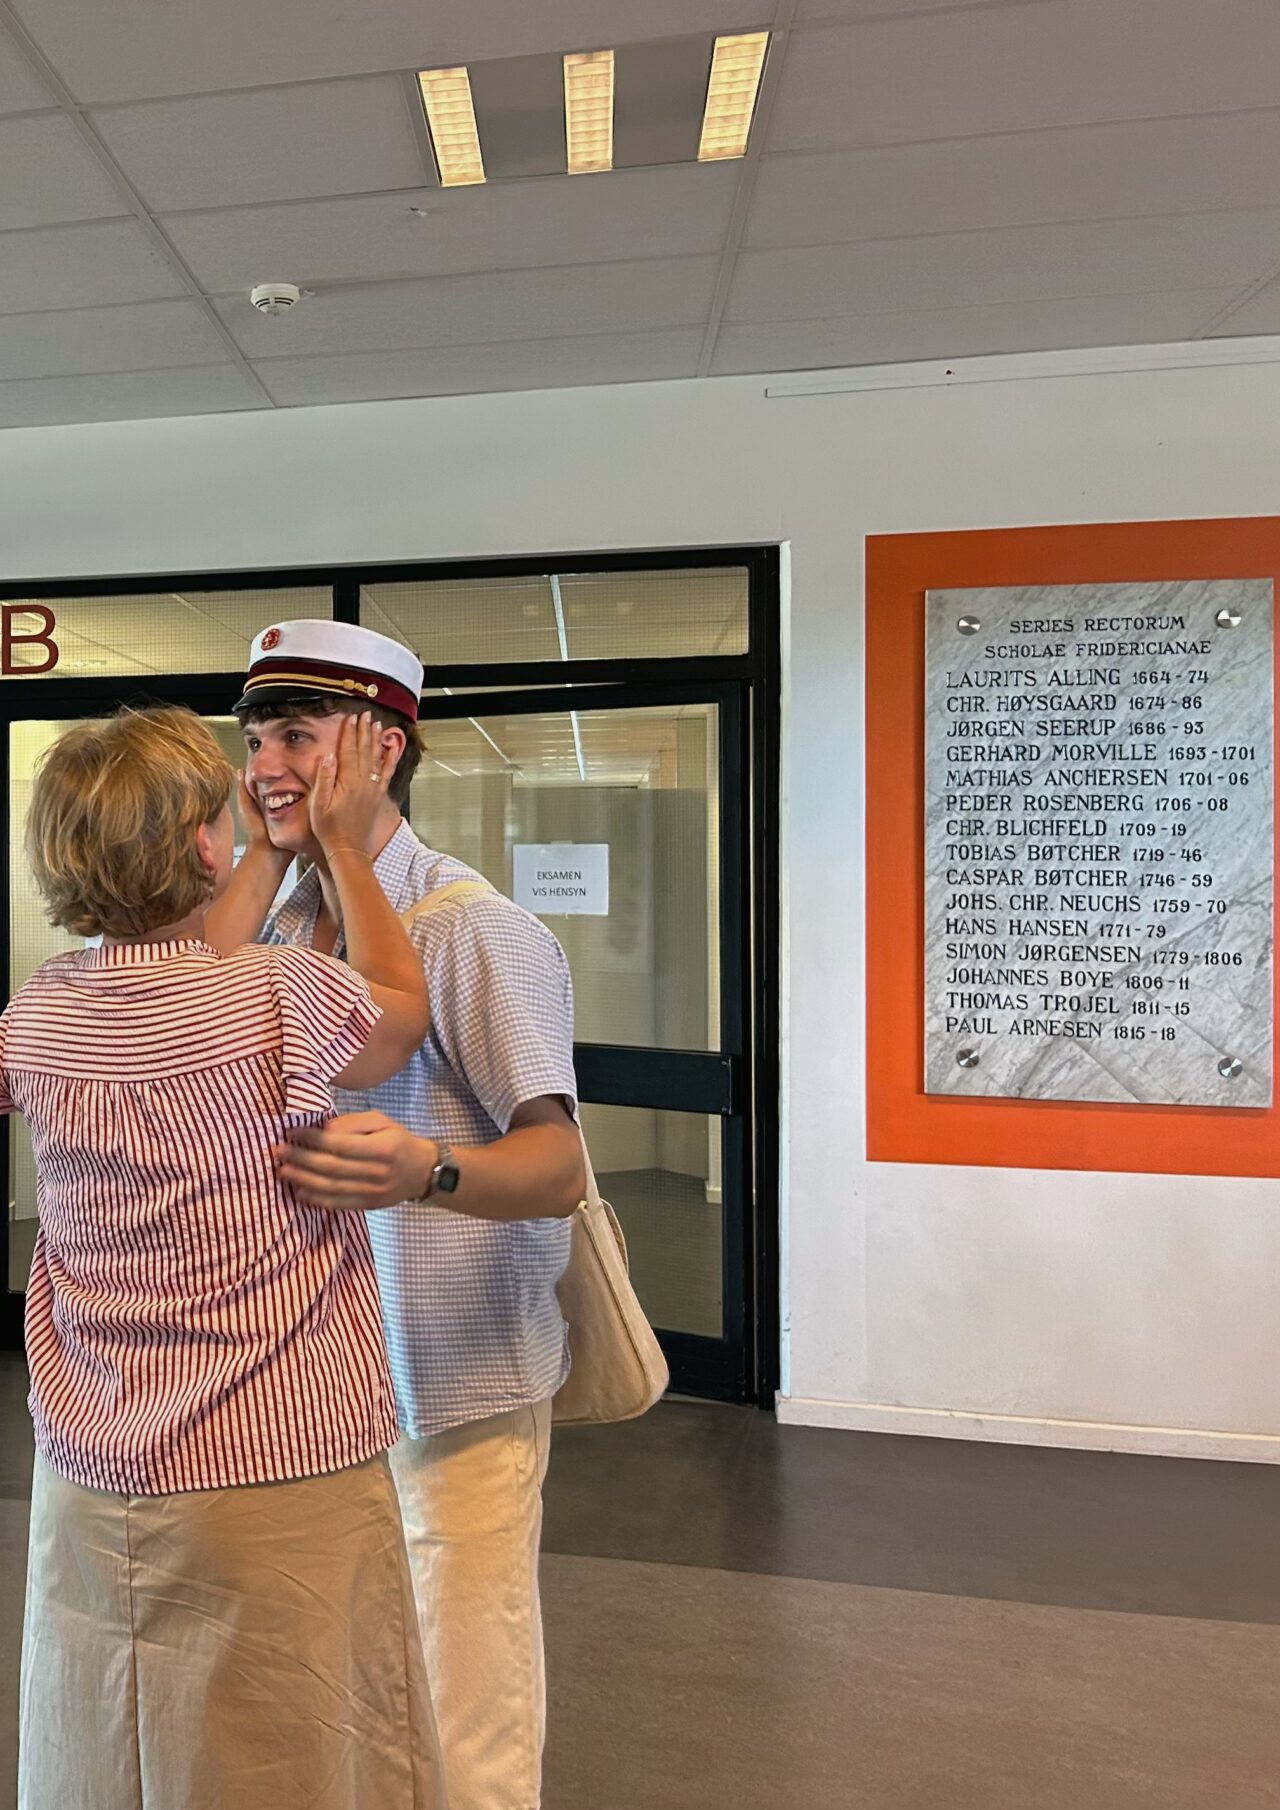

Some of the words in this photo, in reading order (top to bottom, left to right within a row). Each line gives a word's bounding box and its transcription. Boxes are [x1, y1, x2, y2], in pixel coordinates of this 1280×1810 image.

[1010, 618, 1074, 634] SERIES
[1084, 616, 1186, 632] RECTORUM
[1, 604, 59, 675] B
[984, 644, 1067, 659] SCHOLAE
[1075, 640, 1212, 657] FRIDERICIANAE
[946, 670, 1037, 688] LAURITS
[1047, 668, 1121, 687] ALLING
[946, 696, 990, 713] CHR.
[997, 694, 1117, 712] HØYSGAARD
[946, 721, 1025, 737] JØRGEN
[1036, 719, 1116, 737] SEERUP
[946, 745, 1041, 762] GERHARD
[1051, 744, 1157, 762] MORVILLE
[945, 770, 1033, 787] MATHIAS
[1044, 769, 1168, 786] ANCHERSEN
[946, 794, 1013, 812] PEDER
[1022, 794, 1144, 812] ROSENBERG
[946, 819, 989, 837] CHR.
[996, 819, 1107, 837] BLICHFELD
[946, 844, 1017, 861] TOBIAS
[1027, 845, 1121, 862] BØTCHER
[536, 871, 582, 880] EKSAMEN
[946, 869, 1024, 886] CASPAR
[1034, 869, 1128, 887] BØTCHER
[531, 887, 547, 896] VIS
[549, 887, 586, 896] HENSYN
[946, 894, 1003, 911] JOHS.
[1009, 894, 1054, 912] CHR.
[1060, 895, 1141, 913] NEUCHS
[945, 919, 997, 936] HANS
[1008, 919, 1088, 938] HANSEN
[945, 943, 1007, 961] SIMON
[1018, 945, 1141, 964] JØRGENSEN
[946, 969, 1049, 986] JOHANNES
[1060, 971, 1114, 989] BOYE
[946, 991, 1029, 1010] THOMAS
[1039, 994, 1120, 1014] TROJEL
[945, 1017, 998, 1035] PAUL
[1008, 1019, 1102, 1038] ARNESEN
